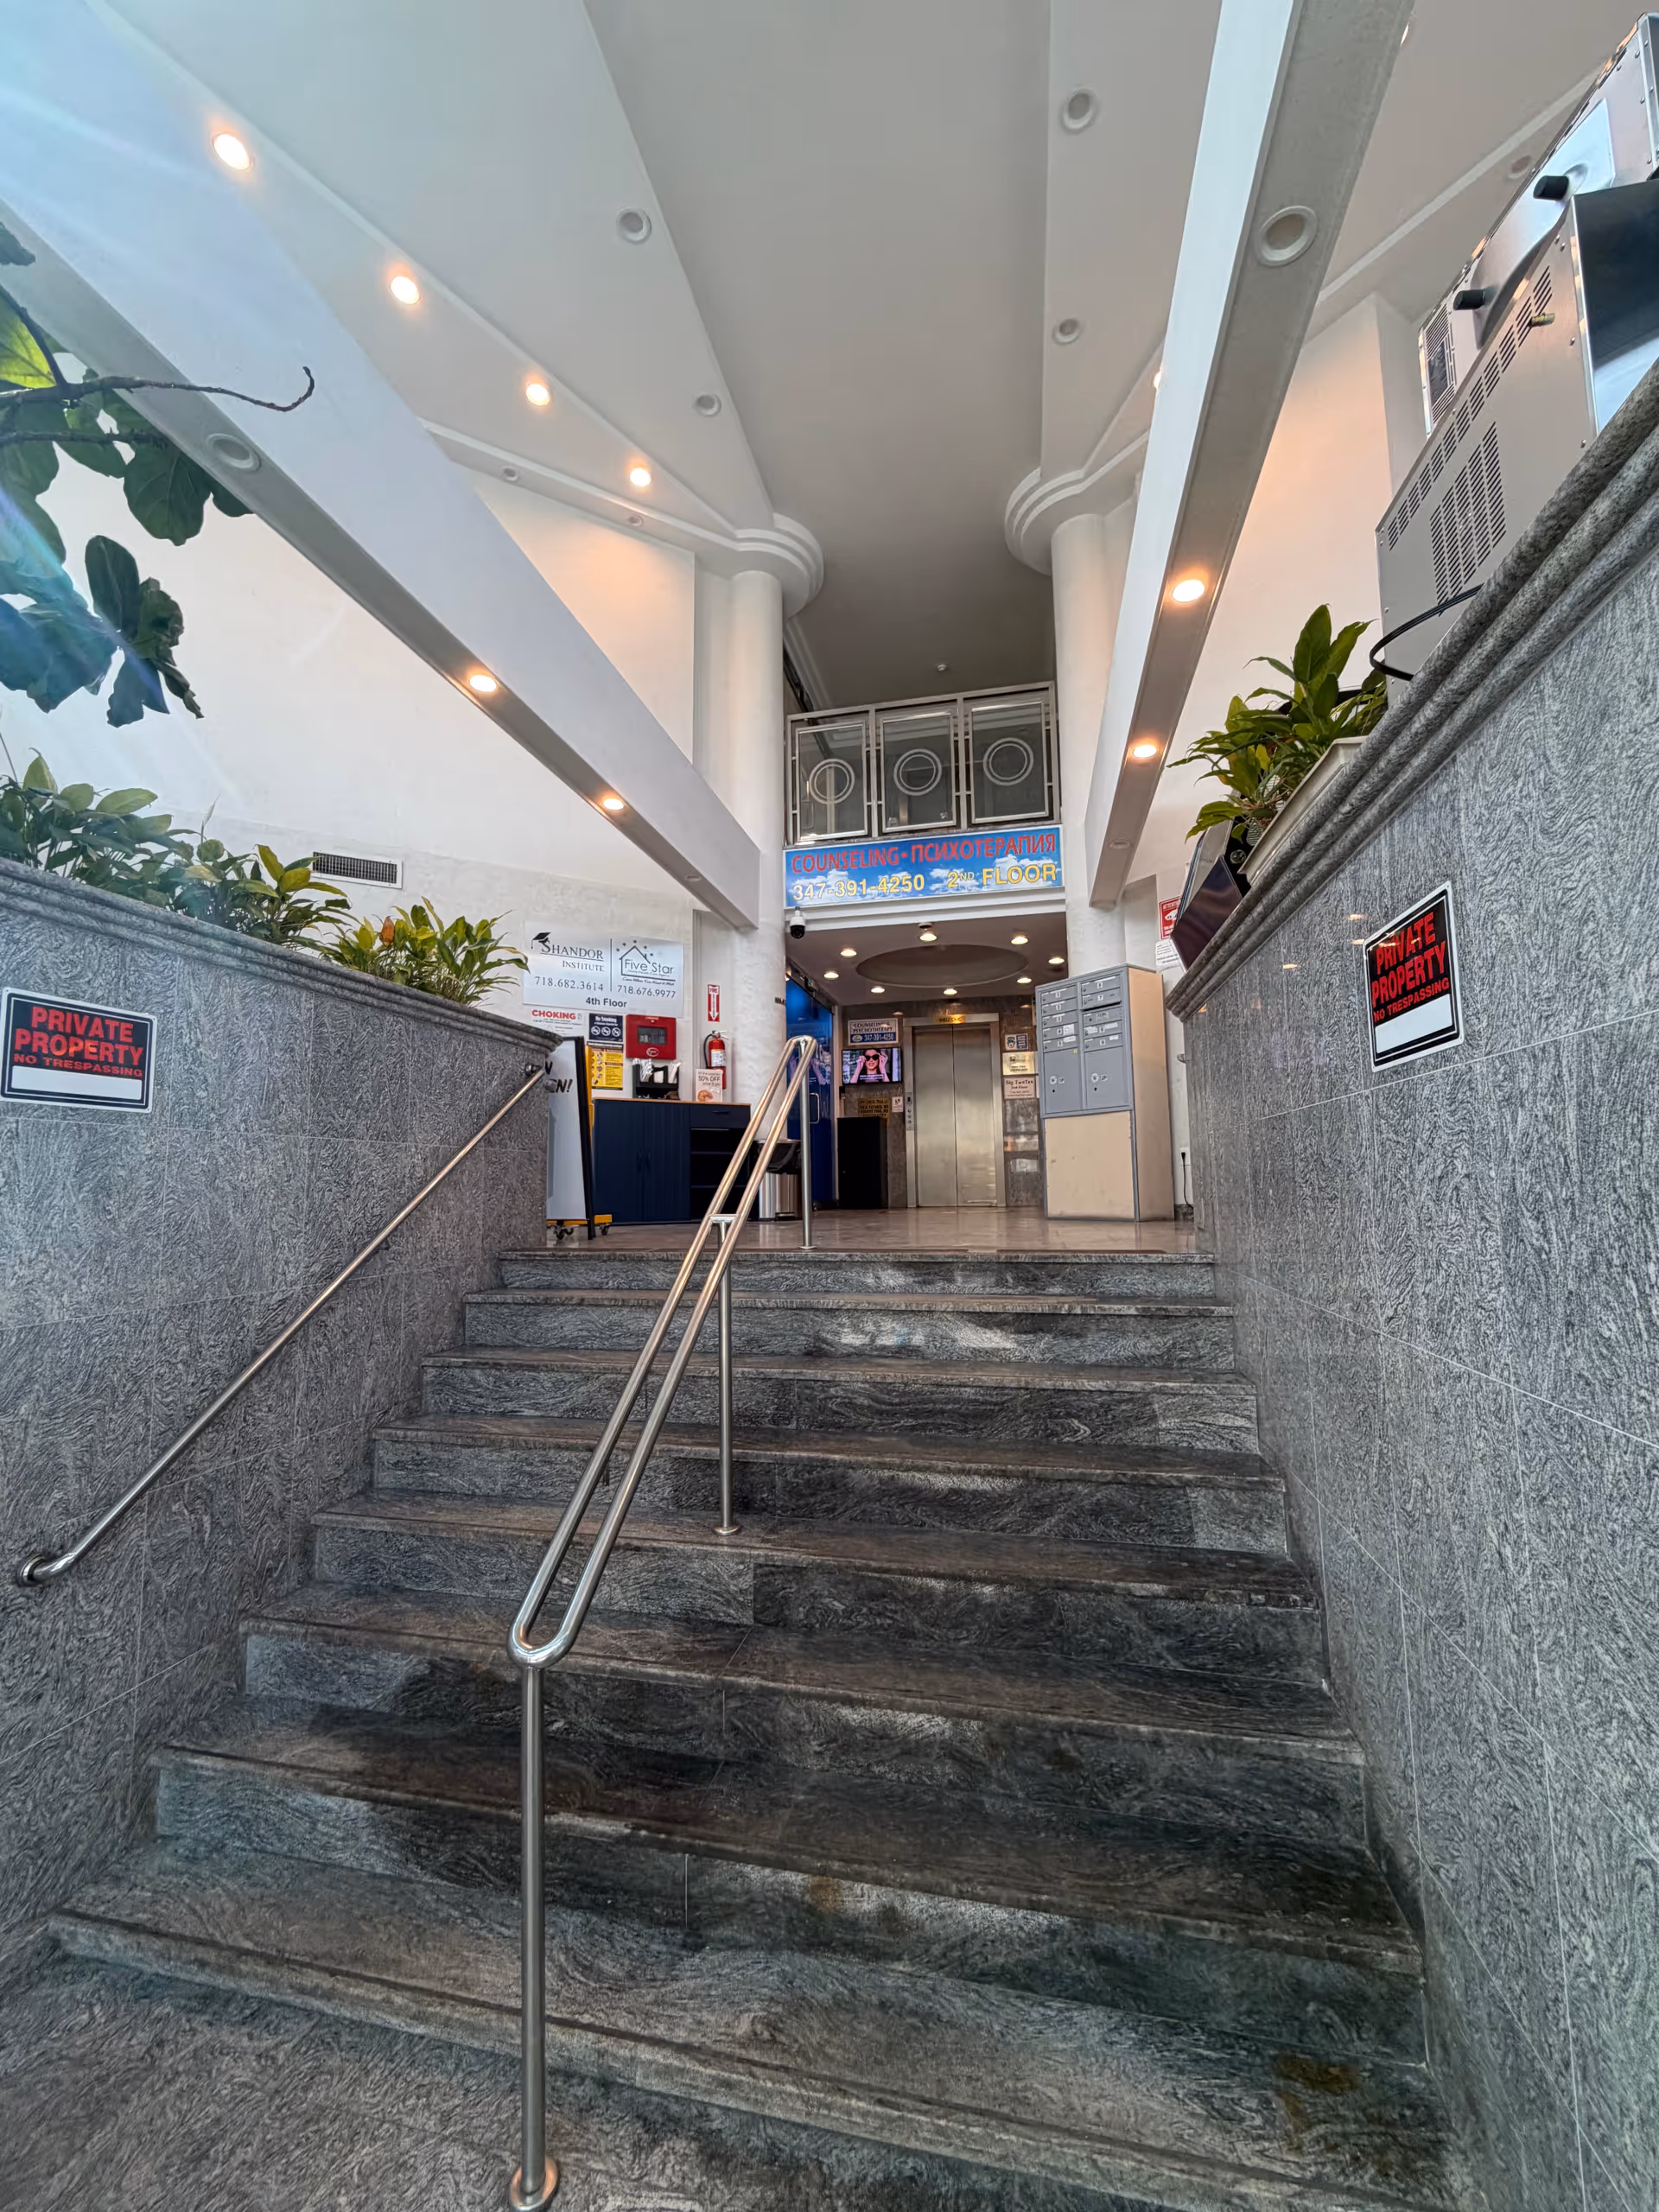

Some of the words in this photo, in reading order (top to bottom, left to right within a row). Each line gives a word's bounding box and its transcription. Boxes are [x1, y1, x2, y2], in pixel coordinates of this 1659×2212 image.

[792, 847, 899, 874] COUNSELING
[912, 834, 1056, 863] ПСИХОТЕРАПИЯ
[793, 874, 925, 901] 347-391-4250
[982, 863, 1057, 887] FLOOR
[541, 941, 604, 960] SHANDOR
[1376, 912, 1436, 976] PRIVATE
[563, 960, 604, 972] INSTITUTE
[625, 958, 648, 971] Five
[652, 962, 674, 974] Star
[1371, 941, 1446, 1007] PROPERTY
[535, 976, 604, 991] 718.682.3614
[618, 985, 676, 998] 718.676.9977
[586, 997, 600, 1006] 4th
[603, 998, 627, 1007] Floor
[1373, 1010, 1385, 1023] NO
[1388, 977, 1450, 1017] TRESPASSING
[31, 1006, 134, 1043] PRIVATE
[531, 1009, 575, 1020] CHOKING
[15, 1028, 143, 1066] PROPERTY
[15, 1053, 37, 1065] NO
[43, 1058, 143, 1077] TRESPASSING
